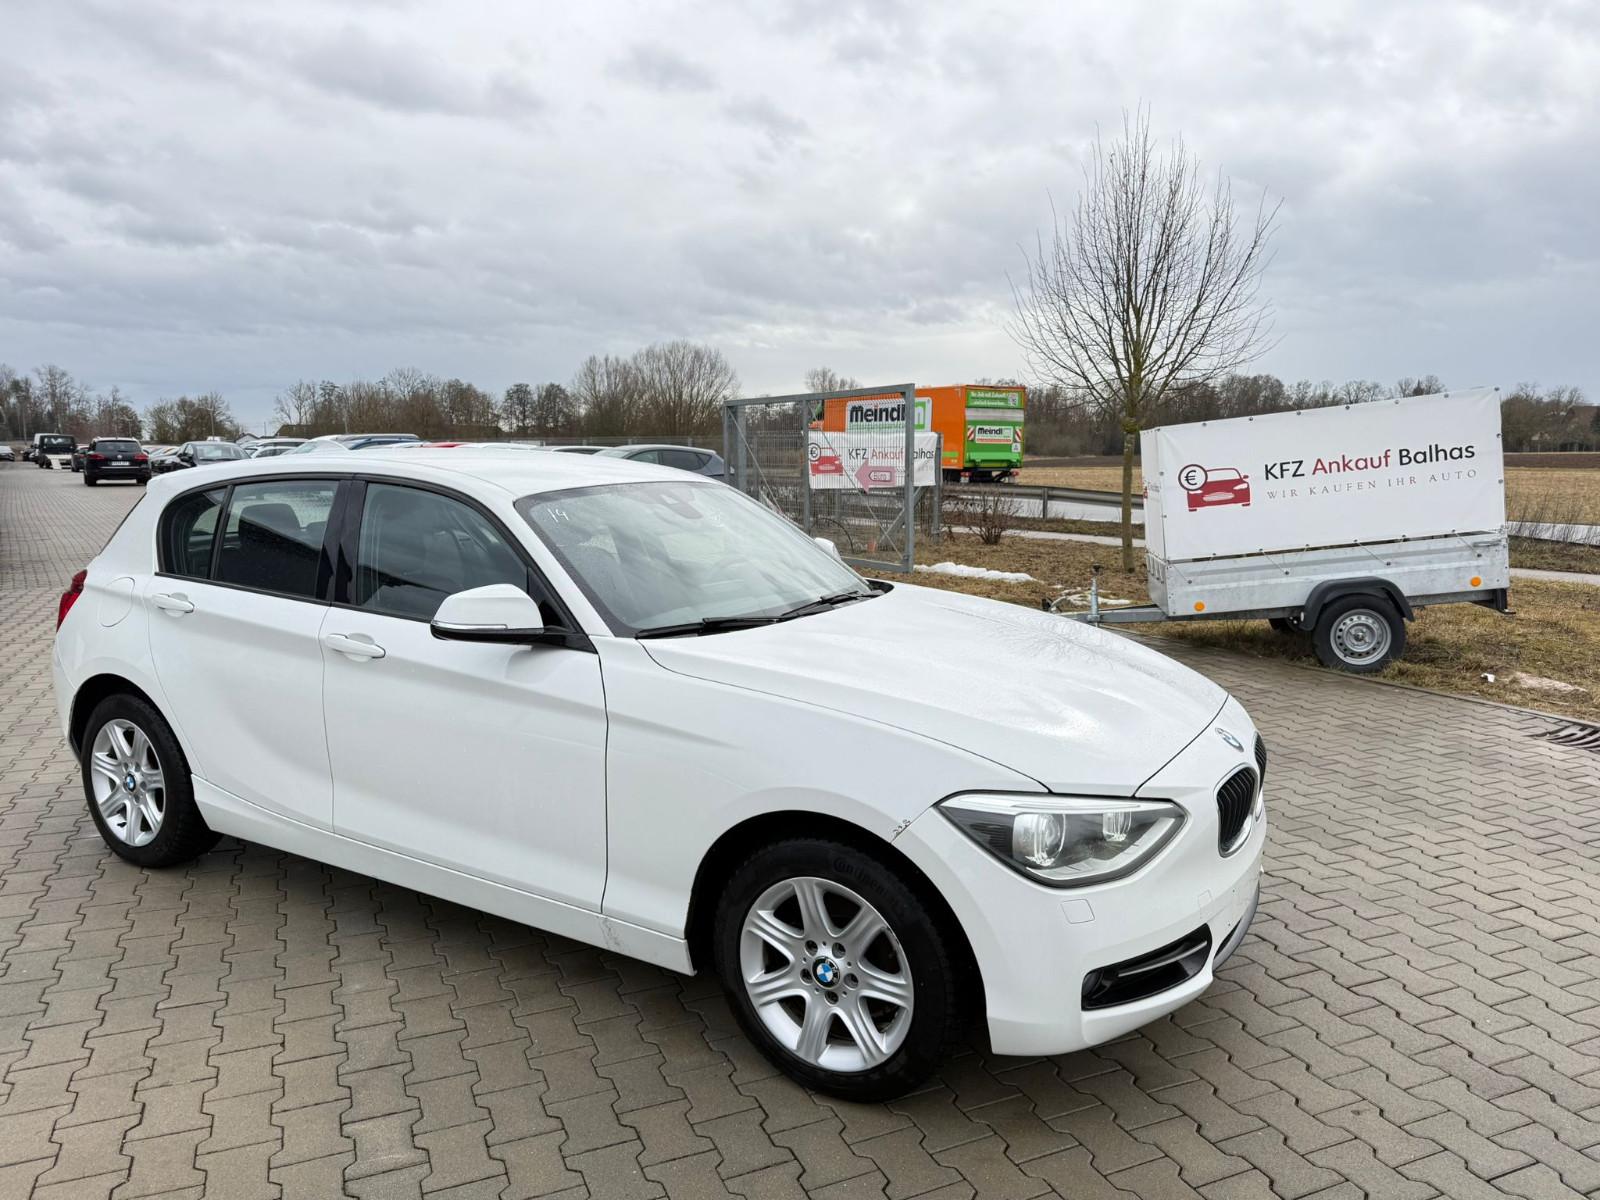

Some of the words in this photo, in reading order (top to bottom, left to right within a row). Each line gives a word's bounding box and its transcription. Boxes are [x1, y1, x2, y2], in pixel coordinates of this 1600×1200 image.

[848, 448, 868, 460] KFZ
[913, 449, 935, 460] alhas
[1264, 459, 1306, 481] KFZ
[1312, 449, 1392, 475] Ankauf
[1399, 443, 1476, 466] Balhas
[1266, 488, 1299, 500] WIR
[1309, 479, 1378, 496] KAUFEN
[1387, 475, 1418, 488] IHR
[1428, 469, 1478, 483] AUTO
